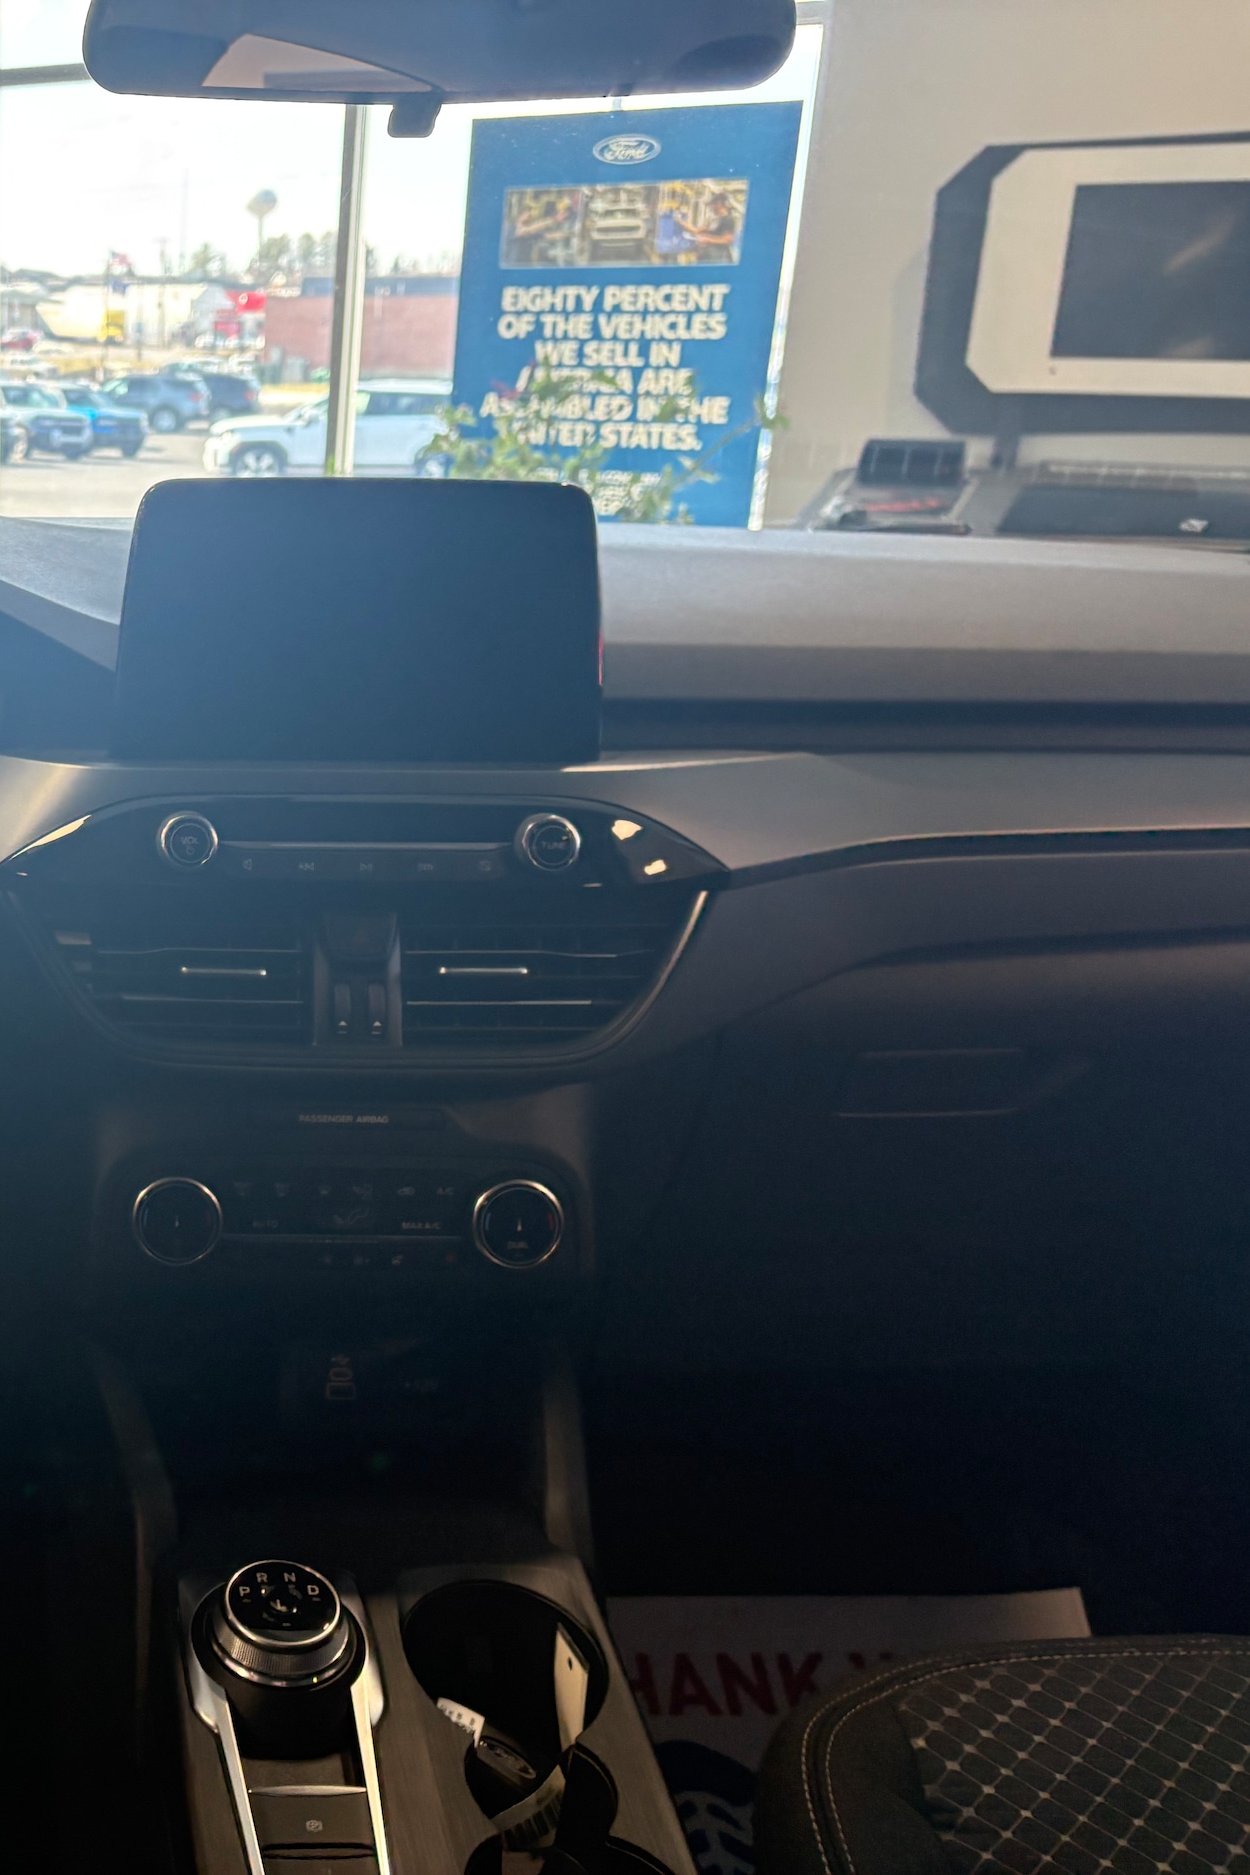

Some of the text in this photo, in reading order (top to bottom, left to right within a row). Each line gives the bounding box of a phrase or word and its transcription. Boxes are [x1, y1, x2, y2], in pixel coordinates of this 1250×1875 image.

[501, 283, 731, 312] EIGHTY PERCENT
[497, 313, 728, 340] OF THE VEHICLES
[534, 340, 682, 367] WE SELL IN
[636, 367, 694, 395] ARE
[599, 421, 703, 451] STATES.
[298, 1114, 389, 1124] PASSENGER AIRBAG
[256, 1572, 268, 1583] R
[283, 1572, 296, 1583] N
[239, 1586, 251, 1597] P
[307, 1585, 320, 1596] D
